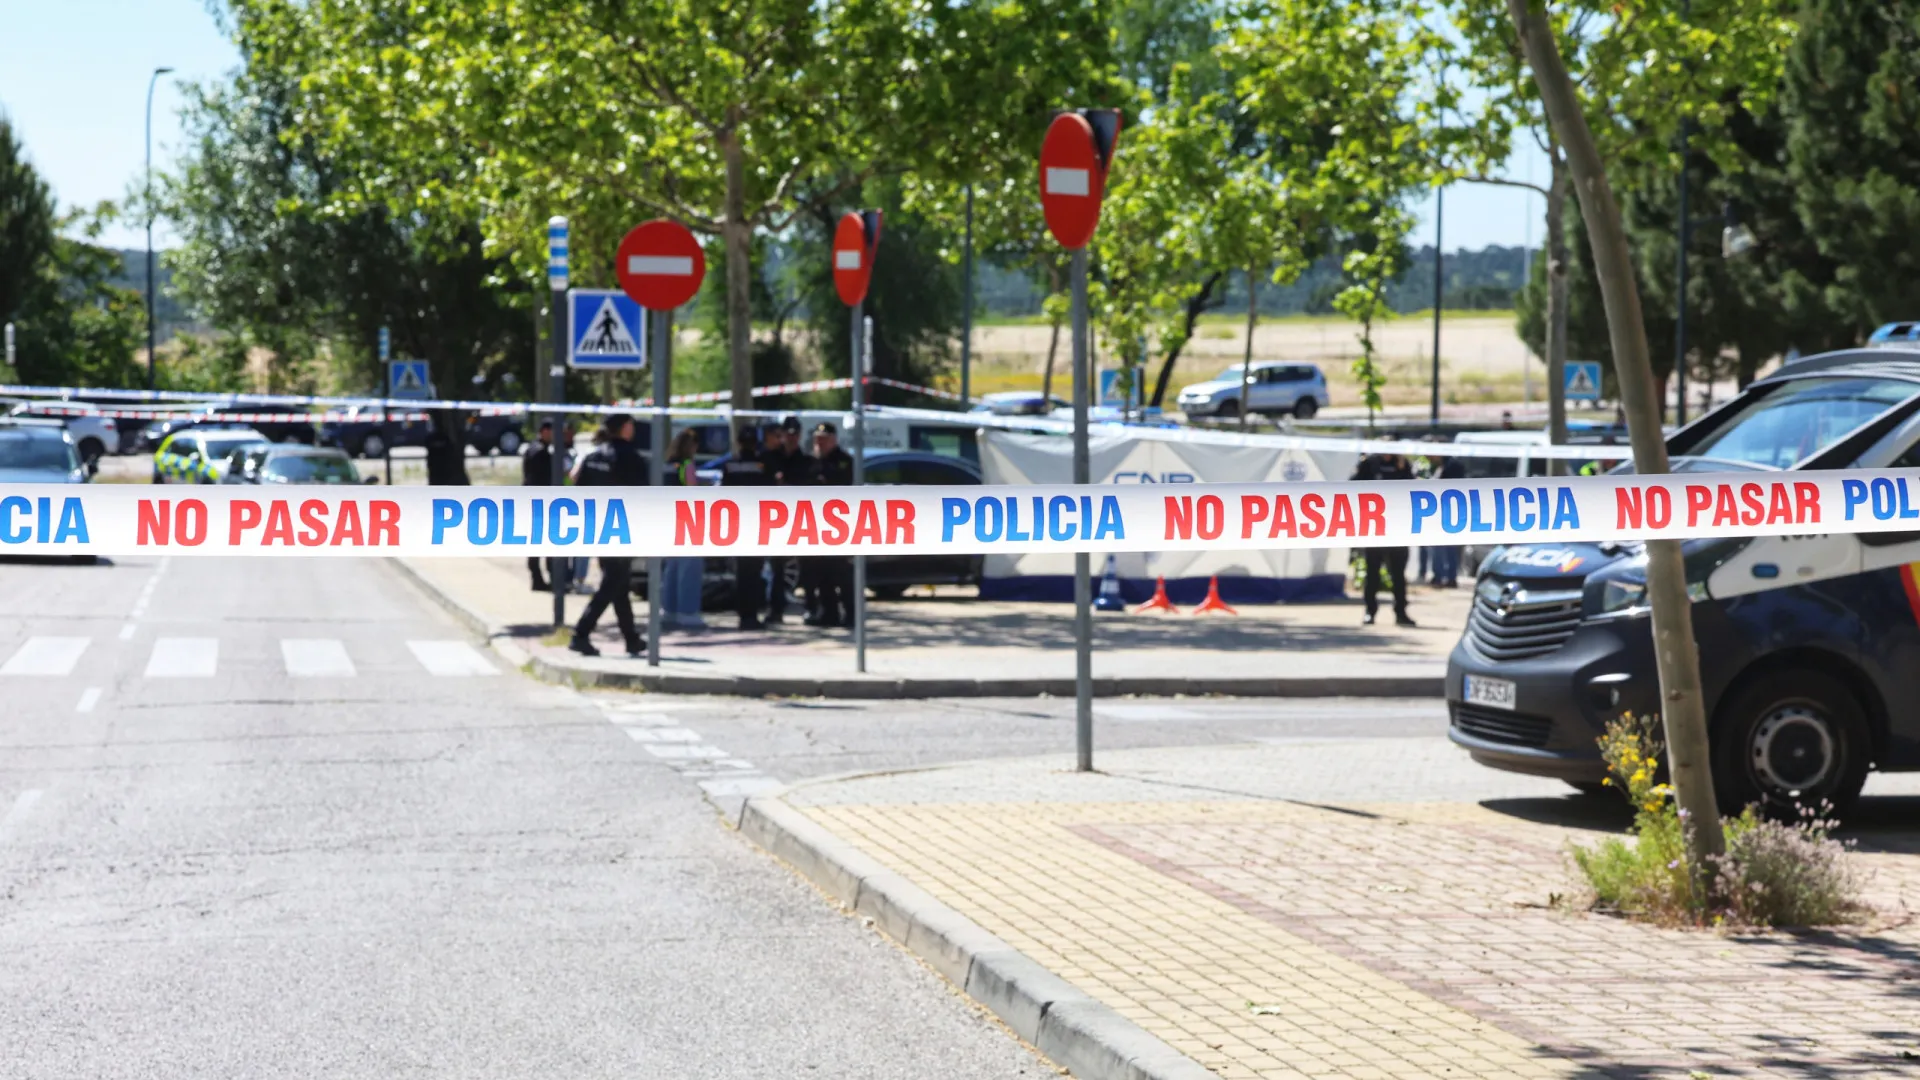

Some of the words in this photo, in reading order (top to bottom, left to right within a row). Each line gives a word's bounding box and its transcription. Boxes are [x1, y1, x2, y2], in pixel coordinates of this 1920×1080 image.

[0, 496, 89, 544] CIA
[138, 499, 207, 546] NO
[230, 499, 400, 546] PASAR
[432, 498, 630, 545] POLICIA
[675, 500, 740, 546] NO
[759, 500, 915, 545] PASAR
[942, 496, 1124, 542] POLICIA
[1165, 495, 1224, 540] NO
[1242, 493, 1385, 538] PASAR
[1411, 488, 1579, 533] POLICIA
[1616, 486, 1671, 529] NO
[1686, 482, 1820, 527] PASAR
[1843, 477, 1920, 520] POL
